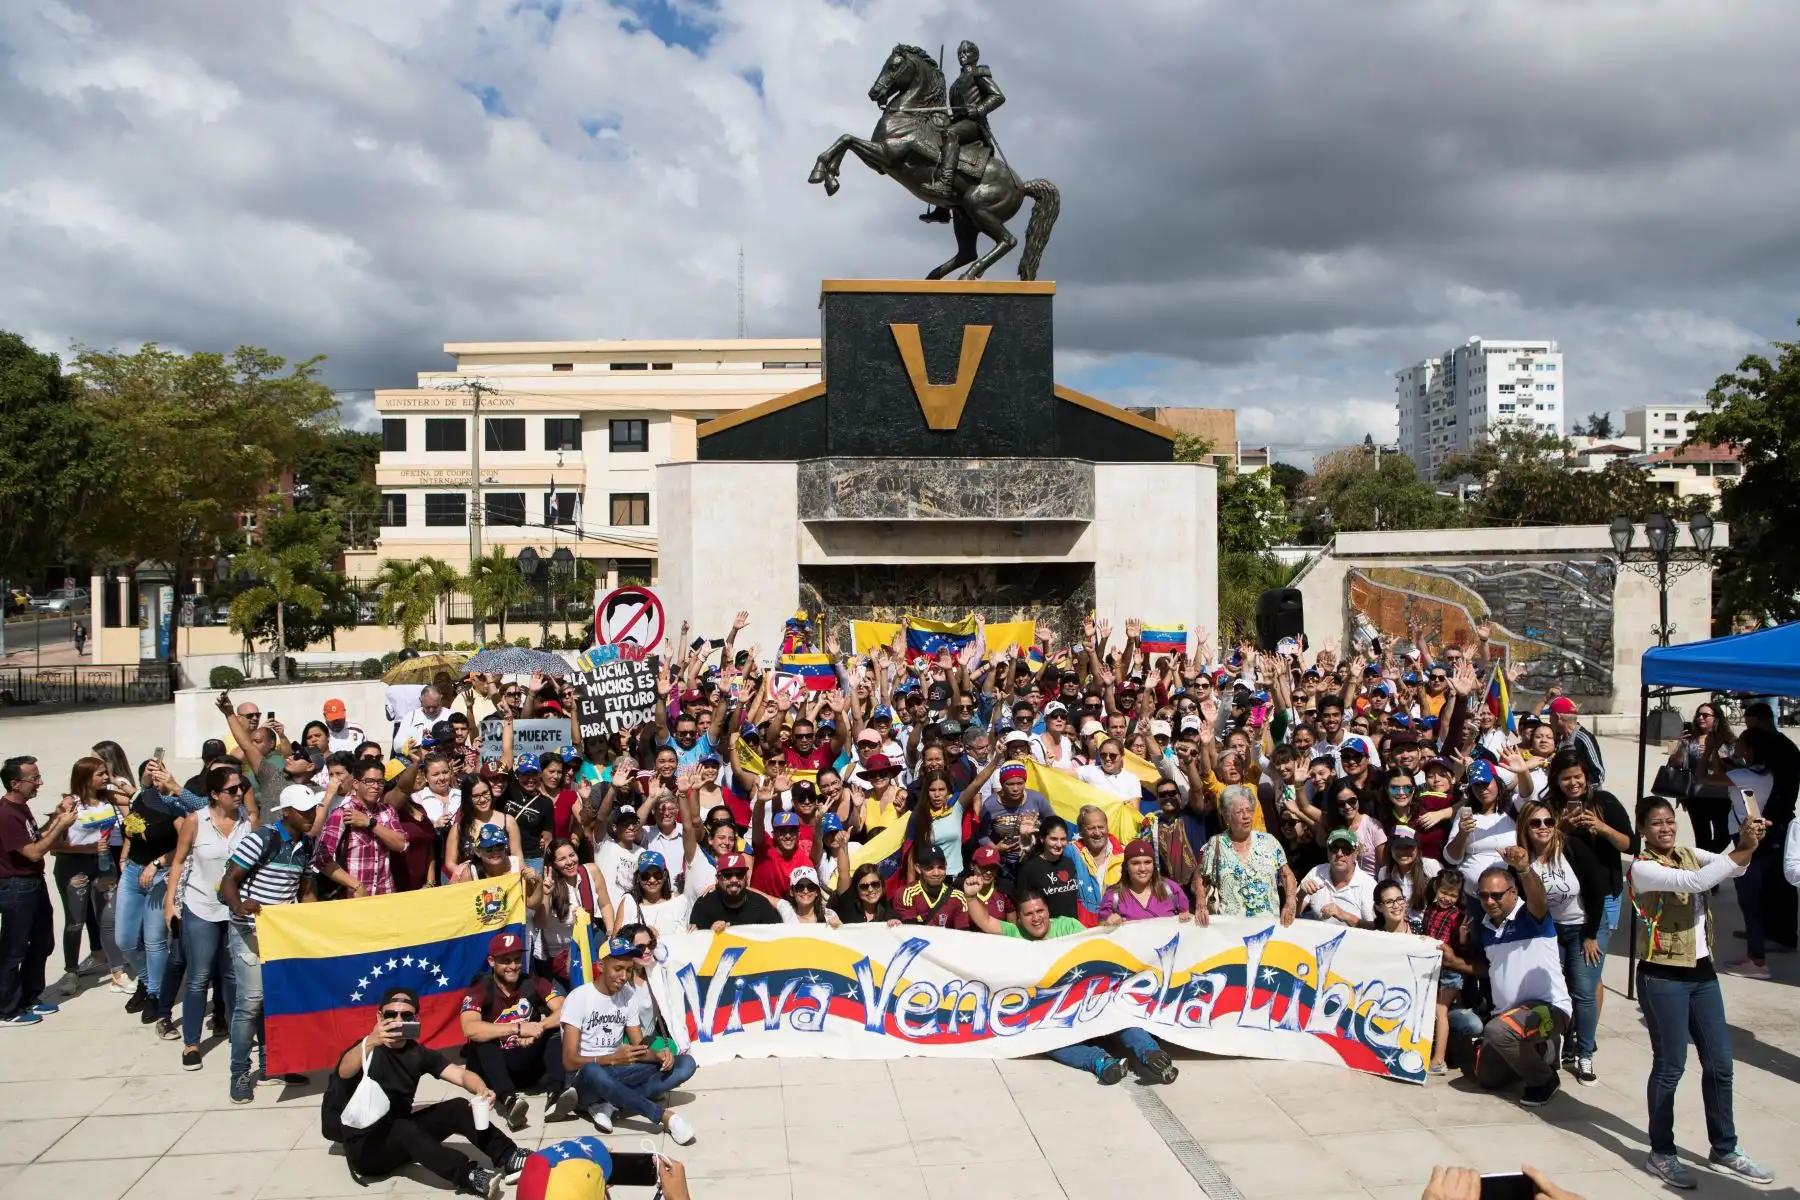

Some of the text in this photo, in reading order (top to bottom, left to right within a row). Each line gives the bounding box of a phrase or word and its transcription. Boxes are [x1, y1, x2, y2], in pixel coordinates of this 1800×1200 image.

[889, 323, 993, 430] V
[385, 399, 515, 407] MINISTERIO DE EDCACION
[577, 642, 646, 673] LIBERTAD
[571, 658, 650, 686] LA LUCHA DE
[586, 673, 655, 697] MUCHOS ES
[581, 691, 655, 716] EL FUTURO
[518, 729, 562, 742] MUERTE
[580, 722, 608, 738] PARA
[1046, 871, 1058, 884] Yo
[1236, 924, 1443, 1074] Libre!
